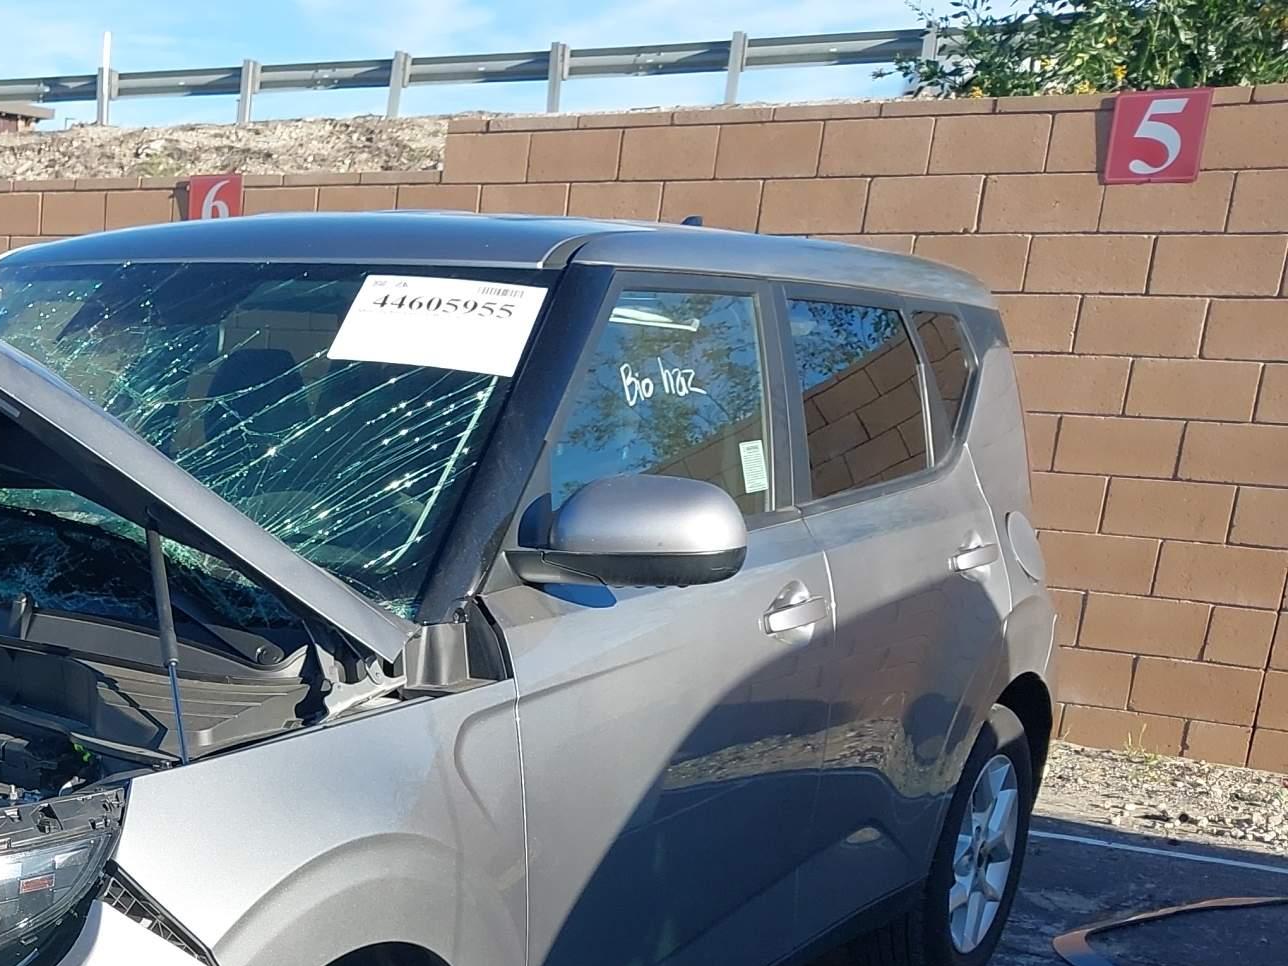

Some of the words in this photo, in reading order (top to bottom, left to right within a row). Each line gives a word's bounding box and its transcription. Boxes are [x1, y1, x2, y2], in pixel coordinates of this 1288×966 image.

[1128, 97, 1190, 175] 5
[201, 180, 230, 219] 6
[372, 293, 516, 319] 44605955
[620, 363, 654, 407] Bio
